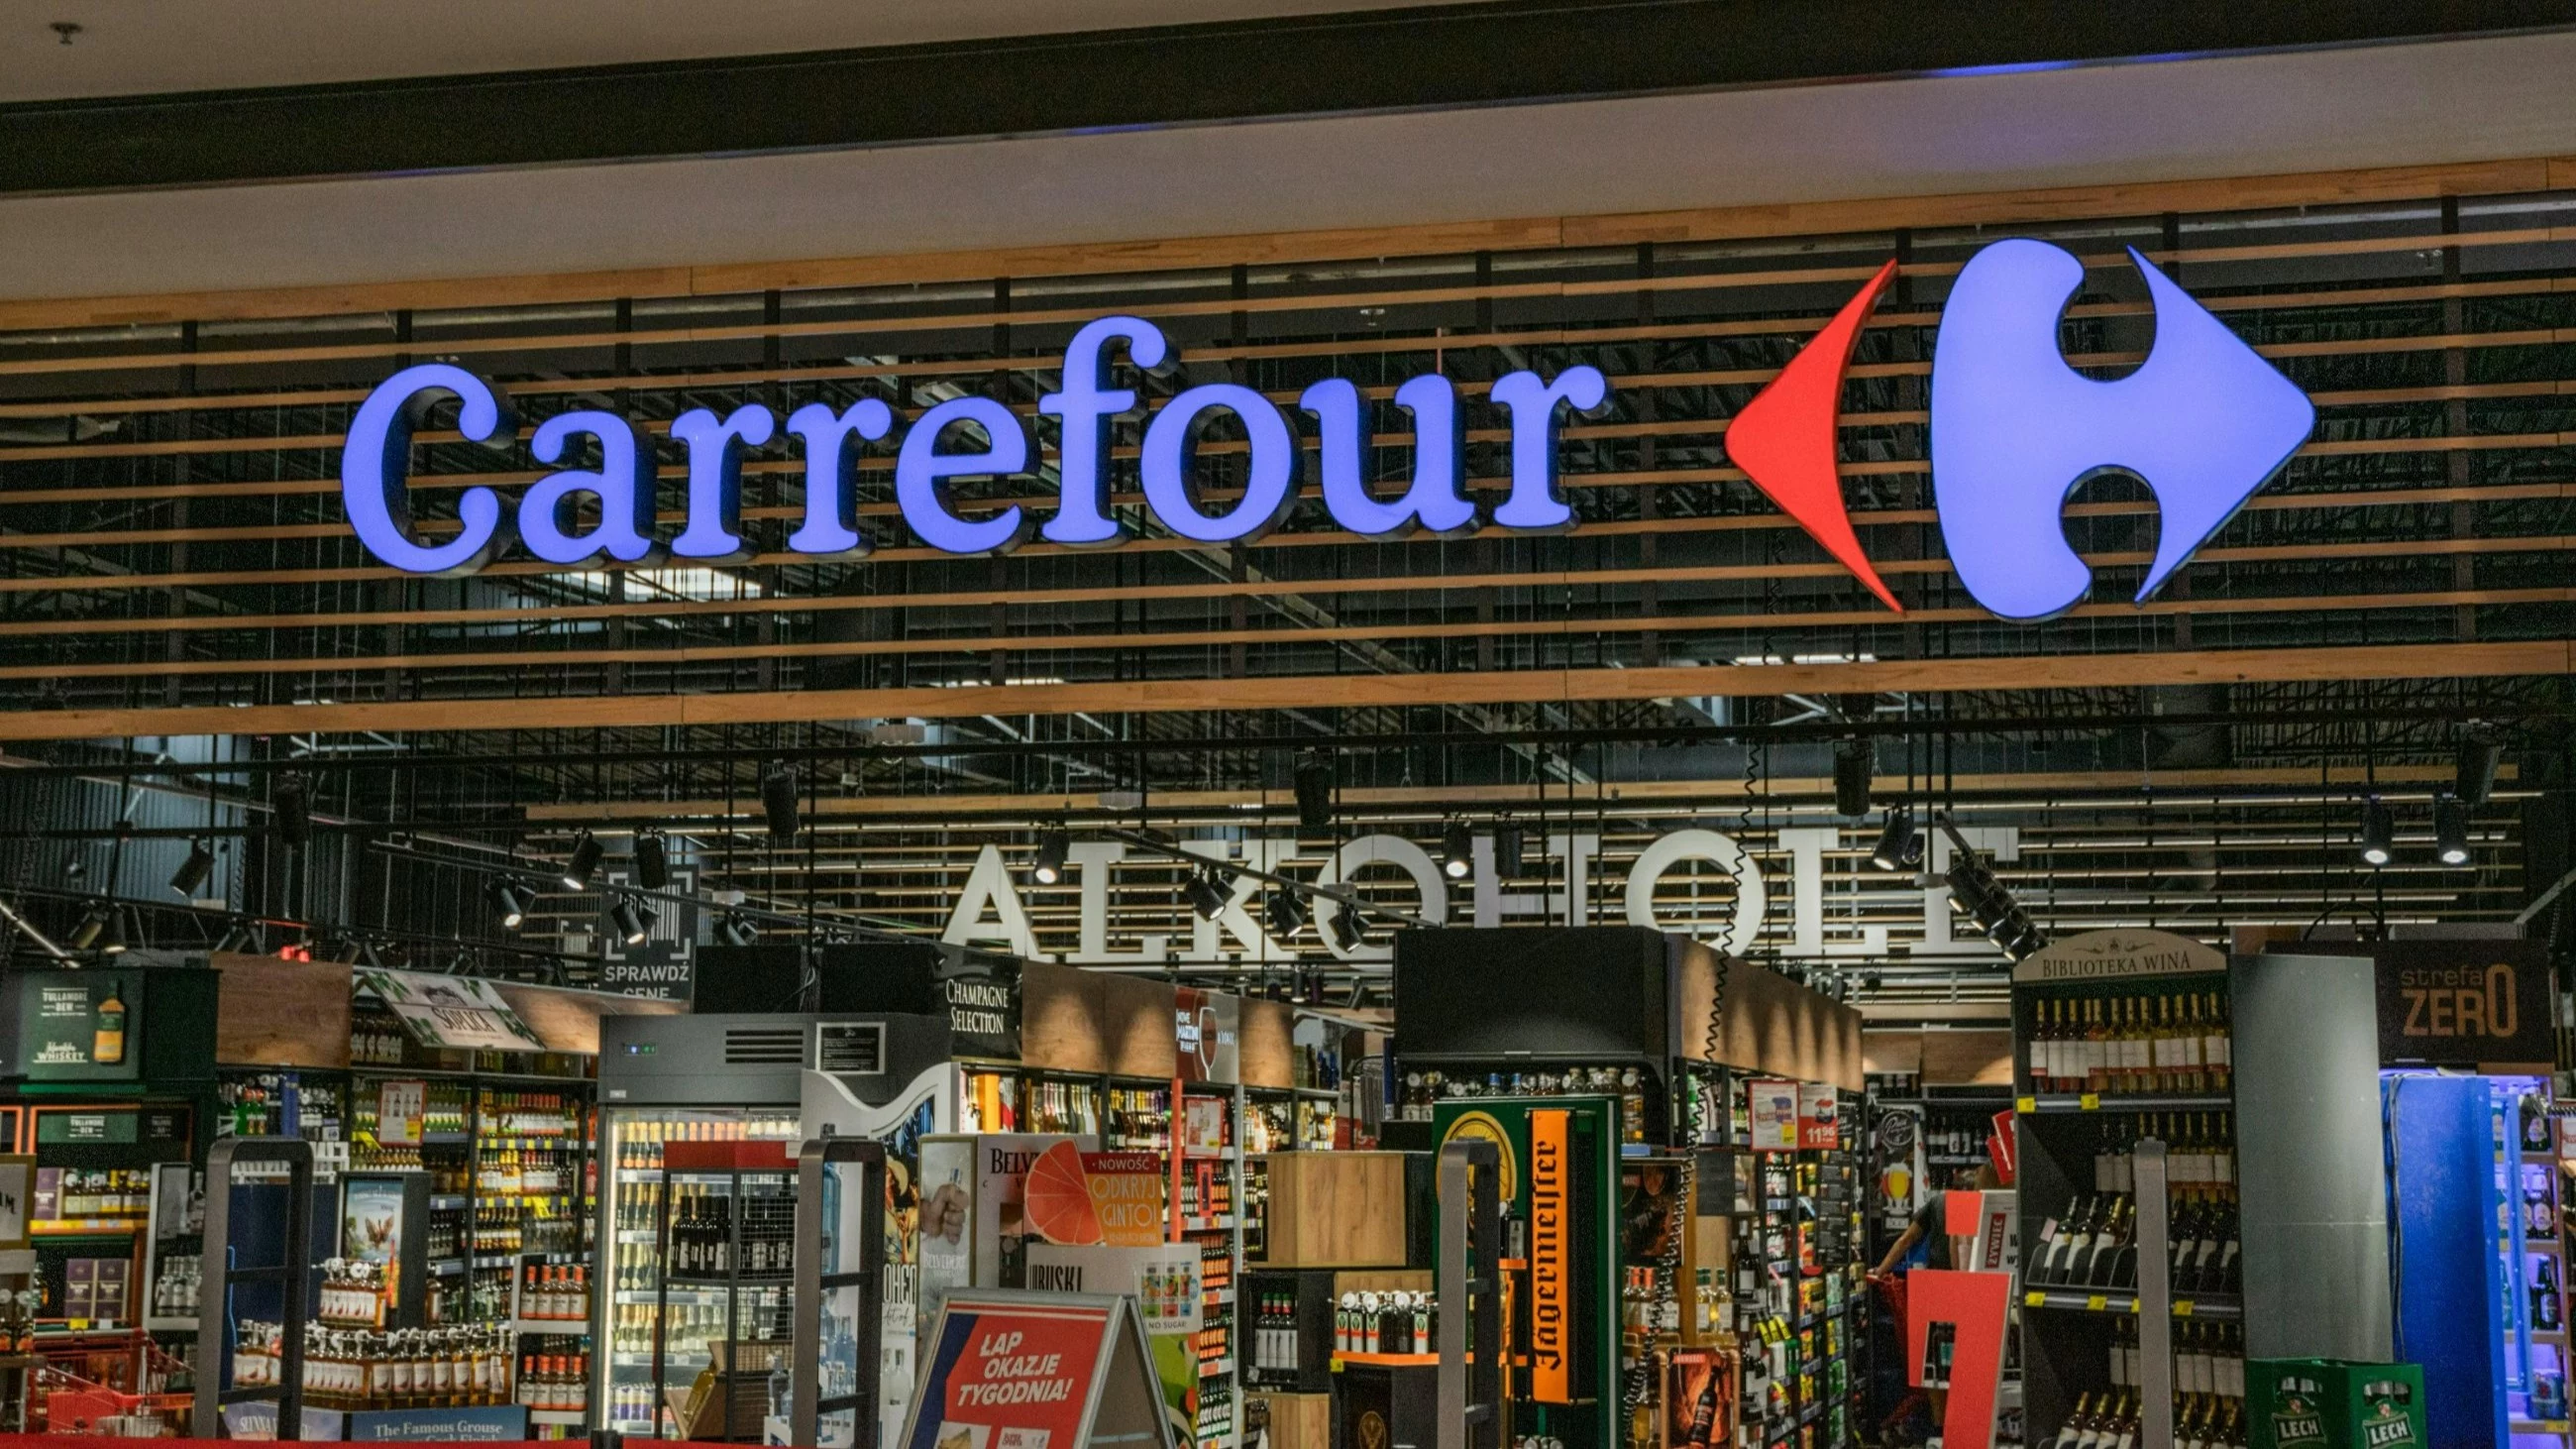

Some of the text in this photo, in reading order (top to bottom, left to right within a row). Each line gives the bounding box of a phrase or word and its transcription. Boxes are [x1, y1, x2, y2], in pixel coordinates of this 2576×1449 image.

[342, 315, 1609, 574] Carrefour
[942, 827, 2019, 965] ALKOHOLE
[604, 961, 690, 982] SPRAWDŹ
[2043, 951, 2192, 978] BIBLIOTEKA WINA
[2401, 965, 2483, 987] strefa
[945, 978, 1009, 1008] CHAMPAGNE
[950, 1006, 1005, 1035] SELECTION
[1093, 1174, 1156, 1198] ODKRYJ
[979, 1331, 1022, 1357] ŁAP
[984, 1354, 1061, 1380] OKAZJE
[957, 1379, 1074, 1407] TYGODNIA!
[374, 1424, 400, 1438] The
[403, 1421, 455, 1434] Famous
[457, 1419, 504, 1434] Grouse
[2280, 1420, 2319, 1438] LECH
[2369, 1421, 2409, 1445] LECH
